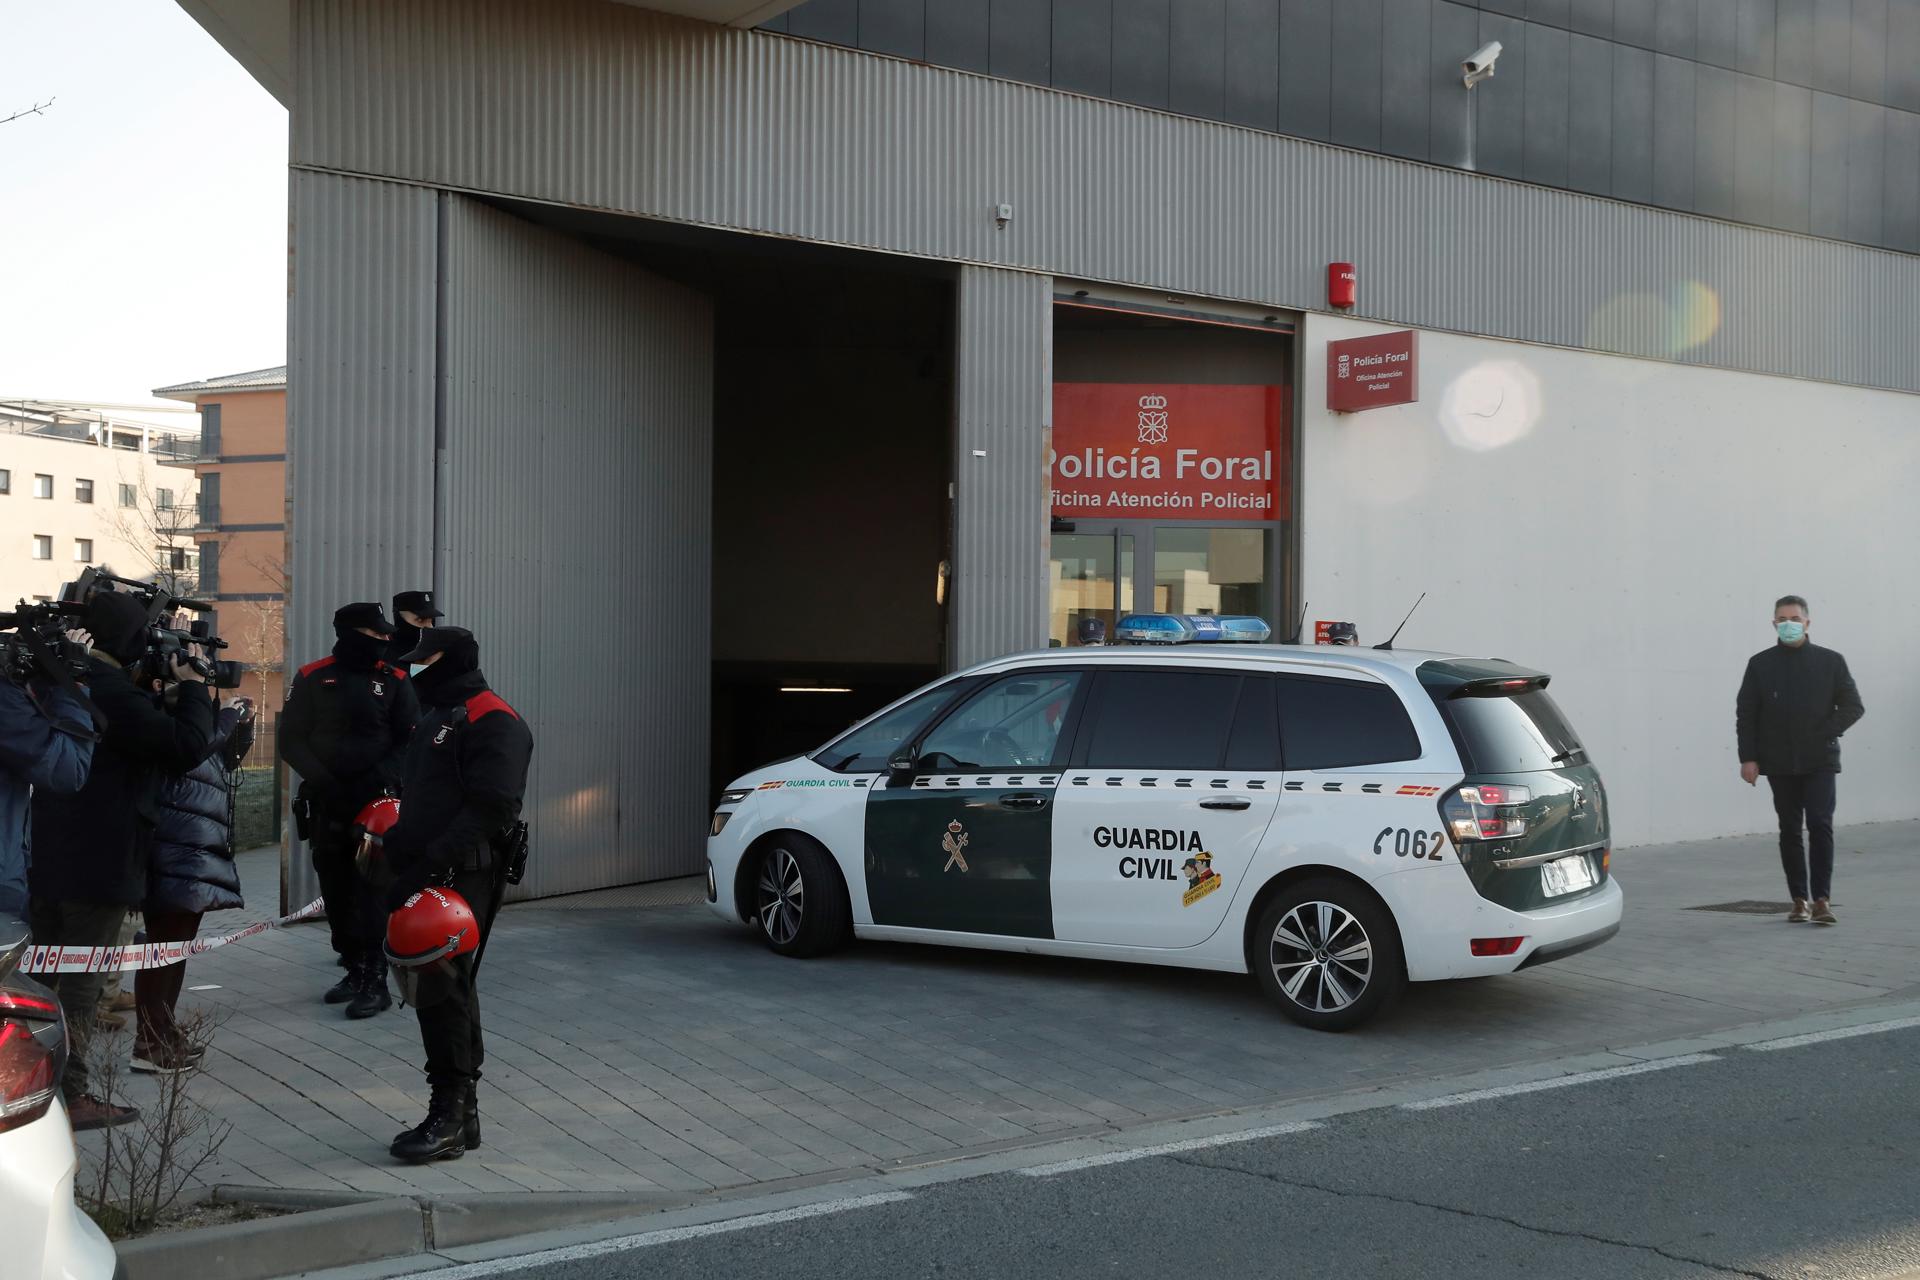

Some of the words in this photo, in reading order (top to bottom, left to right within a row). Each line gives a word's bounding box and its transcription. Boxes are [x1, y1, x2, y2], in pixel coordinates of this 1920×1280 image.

[1354, 354, 1383, 367] Policía
[1385, 351, 1408, 363] Foral
[1356, 373, 1377, 382] Oficina
[1376, 370, 1403, 379] Atención
[1368, 382, 1390, 391] Policial
[1176, 448, 1272, 481] Foral
[1050, 490, 1102, 507] ficina
[1106, 490, 1193, 508] Atención
[1201, 492, 1272, 509] Policial
[1093, 826, 1204, 852] GUARDIA
[1394, 828, 1445, 861] 062
[1118, 856, 1178, 881] CIVIL
